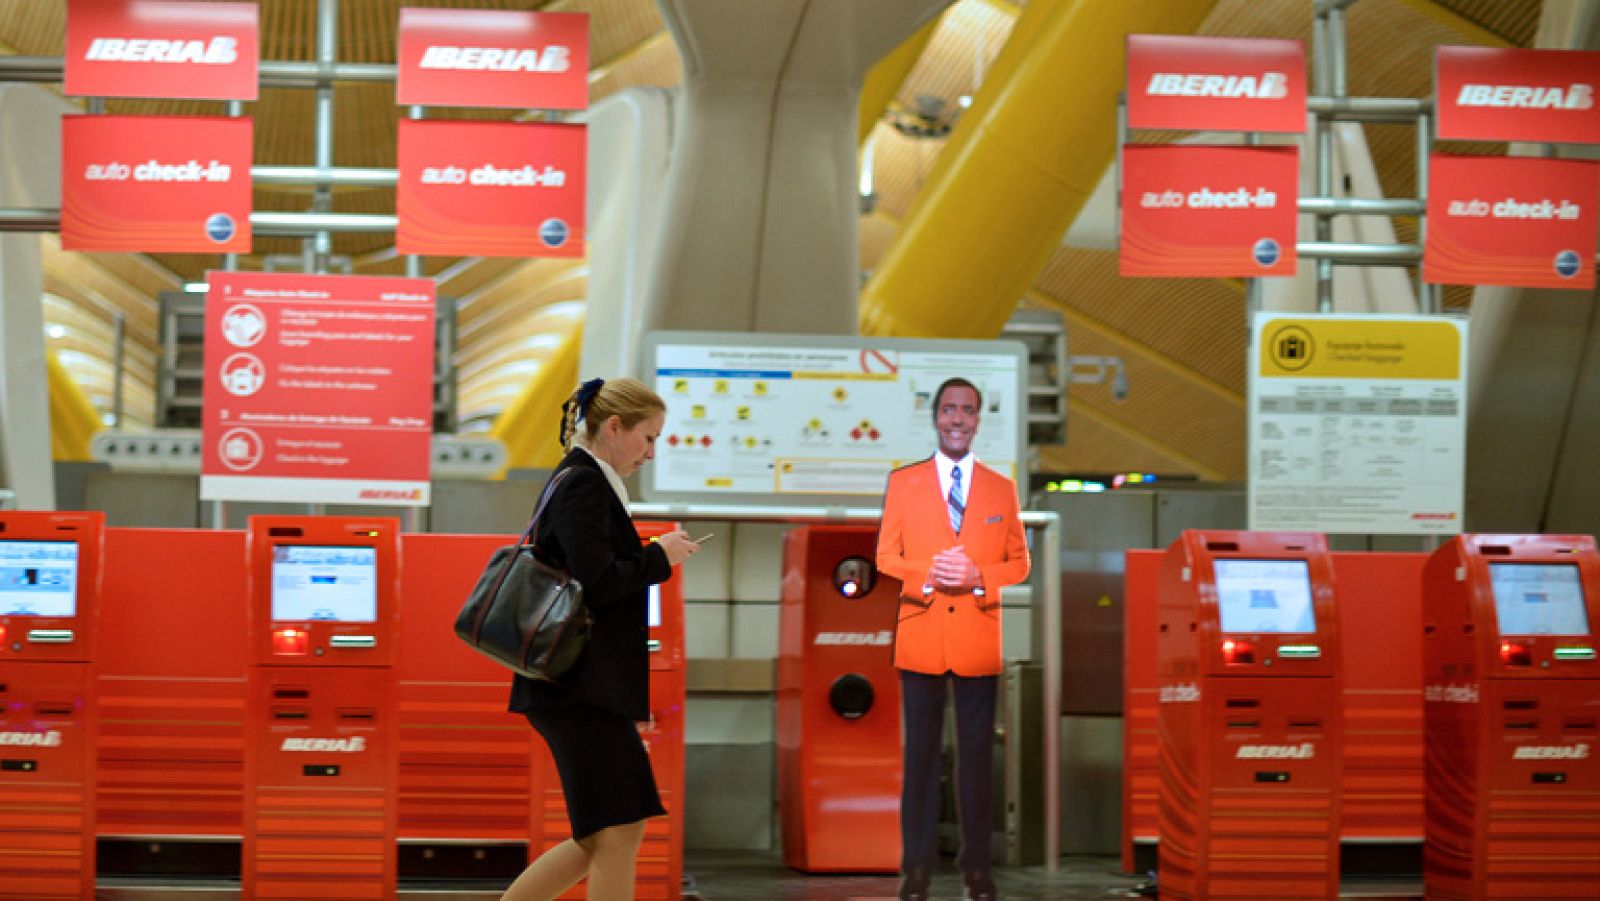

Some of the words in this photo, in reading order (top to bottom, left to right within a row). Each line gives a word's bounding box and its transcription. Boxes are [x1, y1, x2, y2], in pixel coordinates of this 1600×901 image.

[85, 38, 204, 64] IBERIA
[418, 46, 538, 72] IBERIA
[1146, 73, 1257, 97] IBERIA
[1456, 84, 1563, 109] IBERIA
[85, 163, 131, 181] auto
[133, 160, 231, 182] check-in
[420, 166, 467, 185] auto
[469, 164, 566, 187] check-in
[1141, 190, 1185, 208] auto
[1187, 187, 1277, 209] check-in
[1448, 200, 1490, 217] auto
[1492, 197, 1580, 220] check-in
